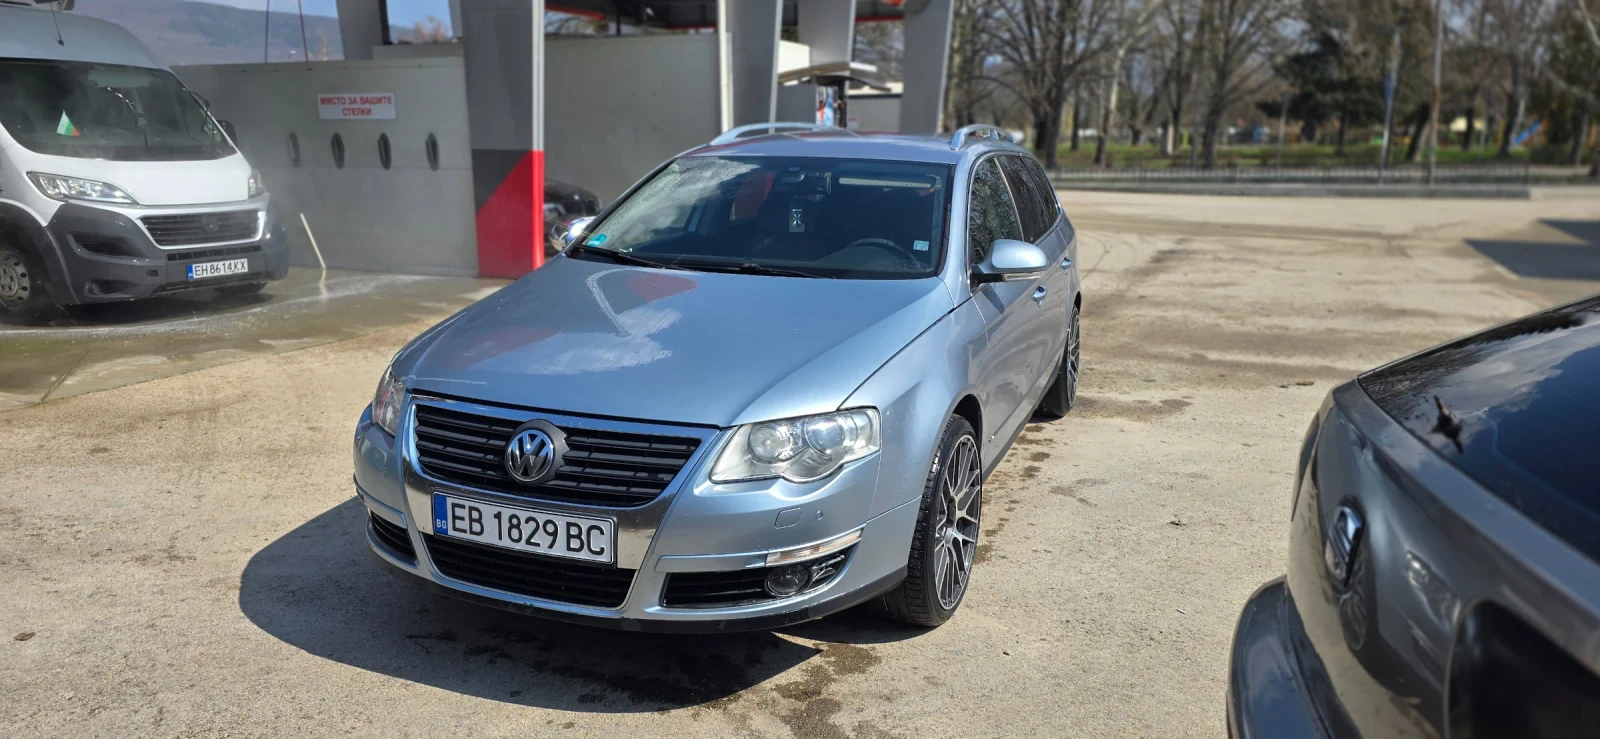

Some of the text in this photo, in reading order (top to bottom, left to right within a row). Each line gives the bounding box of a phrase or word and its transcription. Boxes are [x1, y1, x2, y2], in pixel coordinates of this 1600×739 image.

[320, 96, 392, 105] МЯСТО ЗА ВАШИТЕ
[342, 107, 372, 116] СТЕЛКИ
[194, 264, 209, 276] EH
[436, 518, 447, 529] BG
[451, 502, 605, 556] EB 1829 BC
